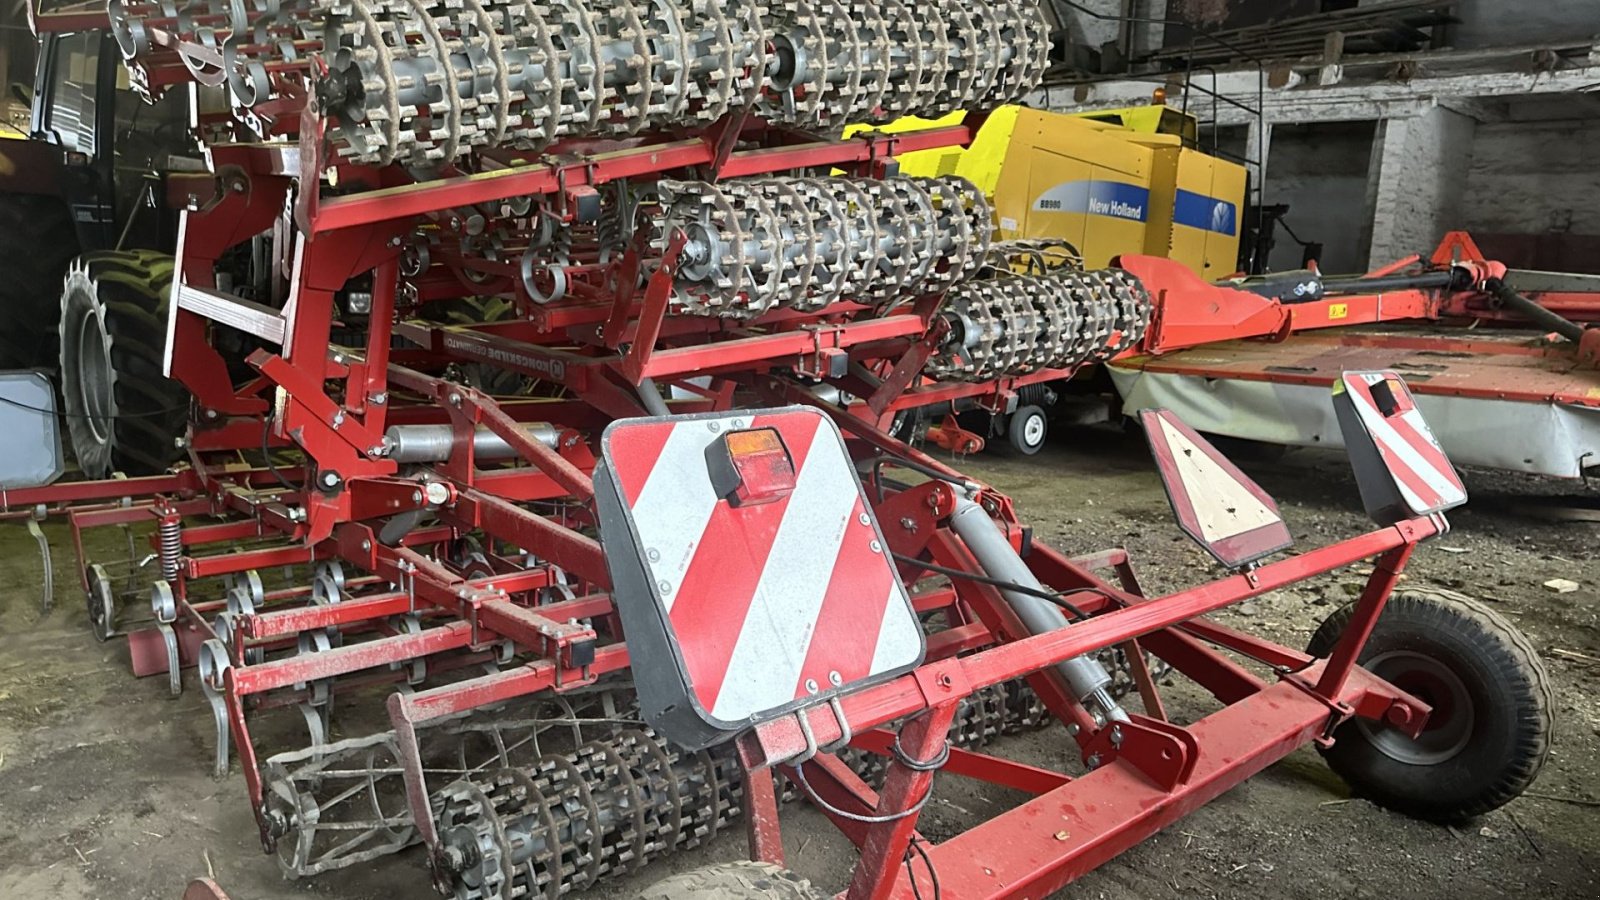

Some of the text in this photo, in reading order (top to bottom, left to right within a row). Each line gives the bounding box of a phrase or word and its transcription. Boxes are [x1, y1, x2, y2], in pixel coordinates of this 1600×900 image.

[1089, 198, 1142, 219] New Holland
[445, 338, 549, 372] KONGSKILDE GERMINATO
